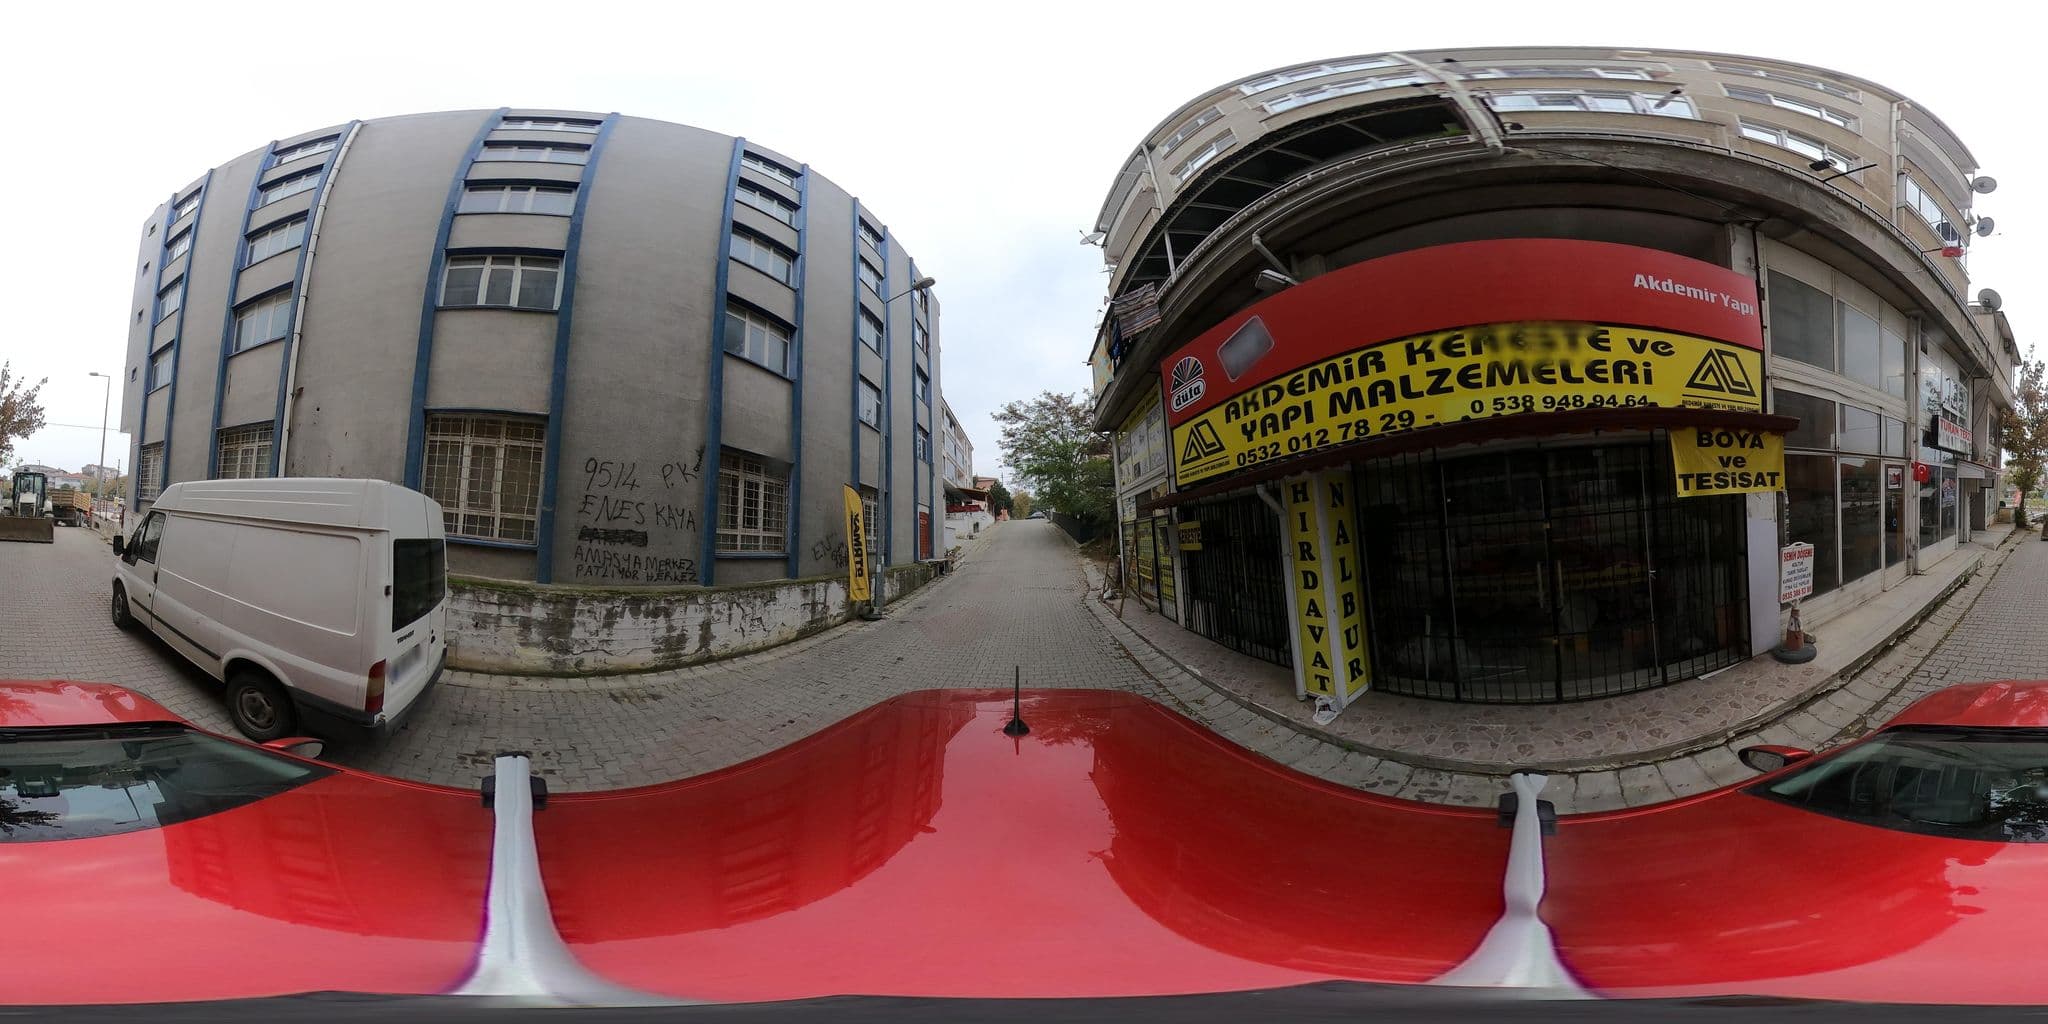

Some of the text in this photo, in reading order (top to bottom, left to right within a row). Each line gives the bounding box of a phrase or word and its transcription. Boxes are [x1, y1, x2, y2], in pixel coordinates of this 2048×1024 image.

[1634, 273, 1754, 316] Akdemir Yapı
[1627, 337, 1675, 357] ve
[1236, 441, 1281, 467] 0532
[1288, 428, 1330, 454] 012
[1337, 418, 1370, 442] 78
[1379, 409, 1415, 432] 29
[1470, 399, 1485, 414] 0
[1492, 394, 1535, 412] 538
[1542, 394, 1584, 409] 948
[1593, 394, 1618, 408] 94
[1624, 394, 1649, 408] 64
[1241, 400, 1314, 442] YAPI
[1696, 430, 1764, 449] BOYA
[585, 457, 640, 491] 9514
[1717, 455, 1746, 468] ve
[578, 494, 696, 532] ENES KAYA
[574, 545, 642, 570] AMASYA
[1291, 481, 1331, 692] HIRDAVAT
[1329, 482, 1364, 683] NALBUR
